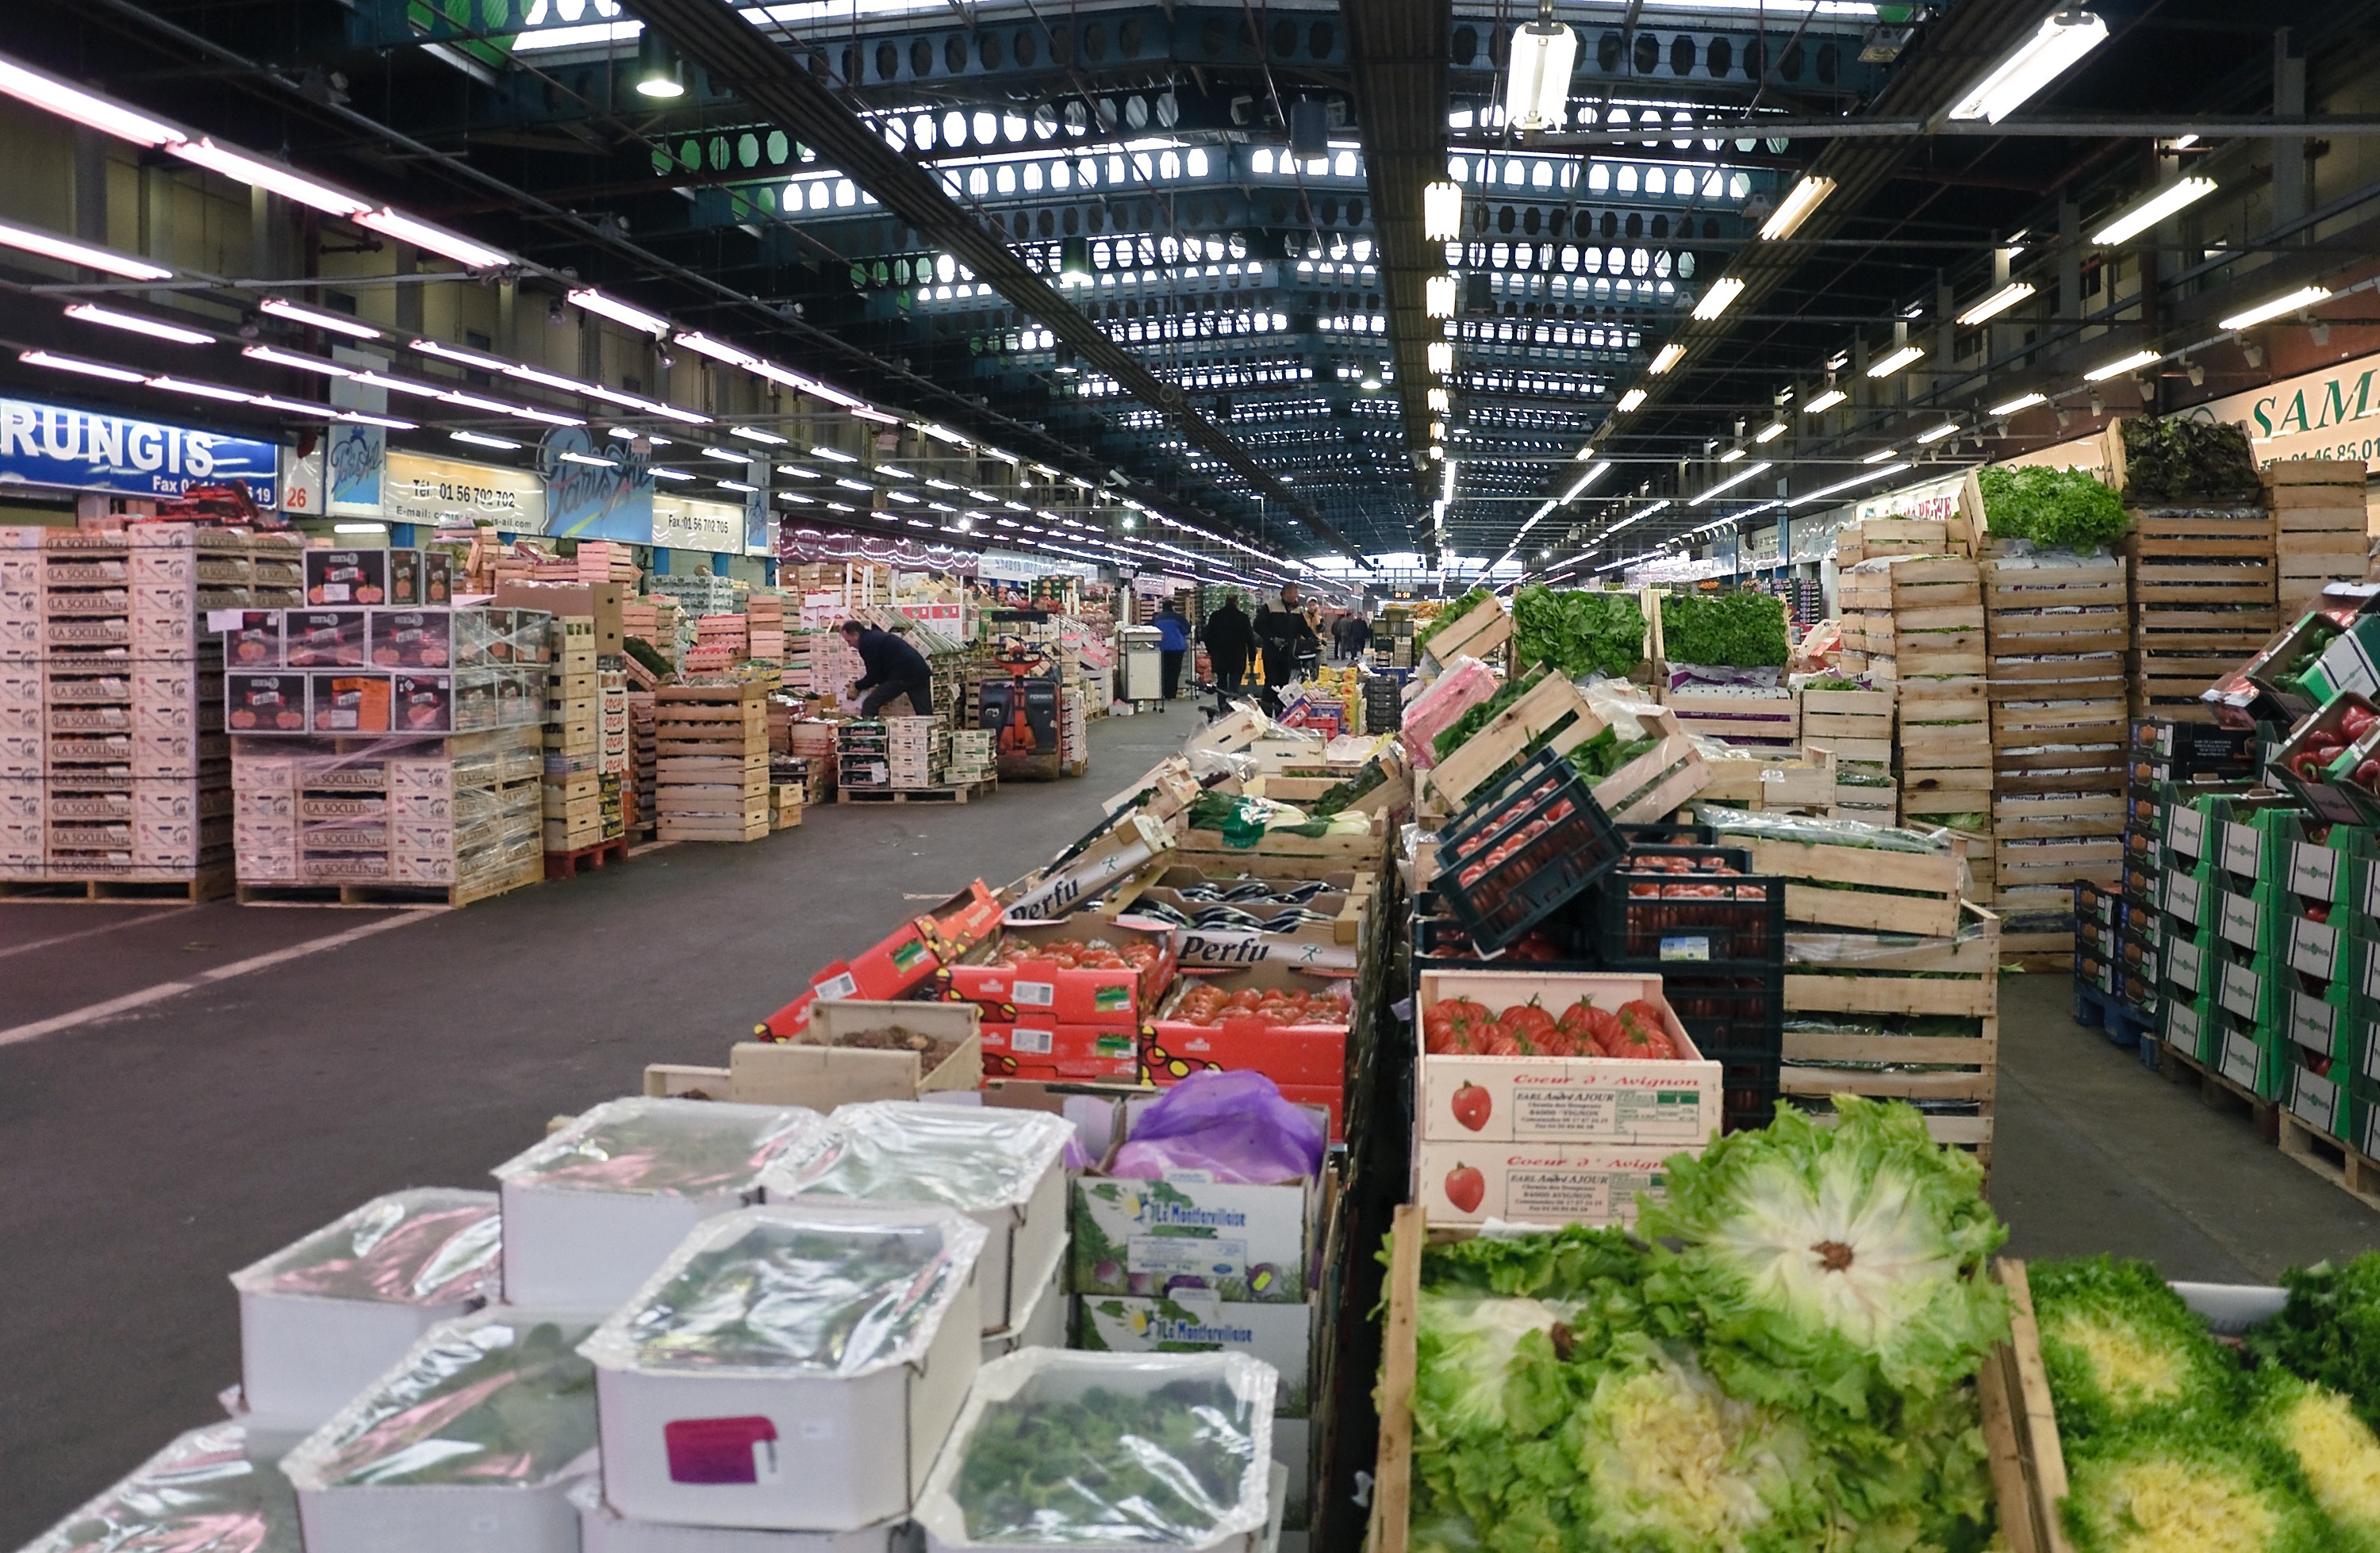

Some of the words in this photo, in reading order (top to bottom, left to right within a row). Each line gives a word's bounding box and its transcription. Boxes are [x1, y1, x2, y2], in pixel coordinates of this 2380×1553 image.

[2253, 369, 2380, 438] SAM
[1, 405, 213, 477] RUNGIS
[152, 475, 178, 493] Fax
[256, 488, 271, 502] 19
[286, 488, 306, 508] 26
[440, 482, 453, 500] 01
[457, 485, 470, 502] 56
[397, 506, 431, 518] E-mail:
[1010, 876, 1079, 920] Perfu
[1178, 936, 1269, 962] Perfu
[1514, 1075, 1574, 1084] Coeur
[1614, 1076, 1699, 1089] Avignon
[1507, 1156, 1568, 1166] Coeur
